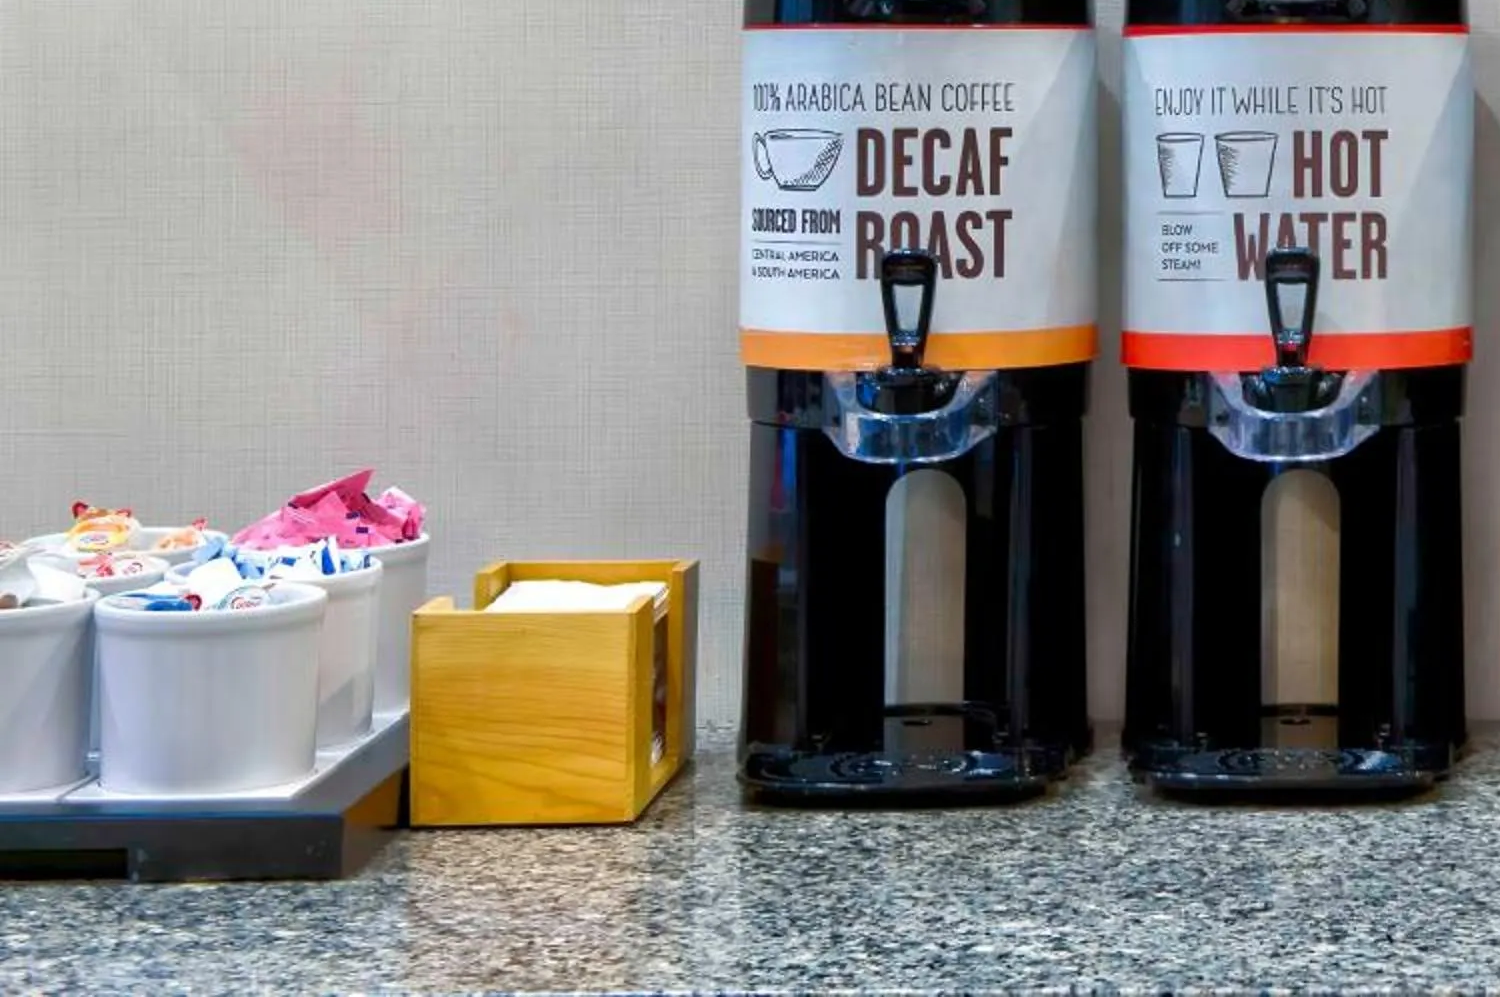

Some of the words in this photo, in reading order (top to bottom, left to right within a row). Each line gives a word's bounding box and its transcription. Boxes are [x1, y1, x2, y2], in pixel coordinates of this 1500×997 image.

[785, 83, 867, 112] ARABICA
[875, 83, 932, 112] BEAN
[941, 83, 1015, 112] COFFEE
[1155, 88, 1204, 116] ENJOY
[1211, 87, 1226, 115] IT
[1233, 86, 1298, 115] WHILE
[1309, 86, 1343, 114] IT'S
[1351, 86, 1388, 114] HOT
[856, 127, 1013, 197] DECAF
[1292, 130, 1389, 198] HOT
[752, 207, 797, 234] SOURCED
[801, 208, 841, 234] FROM
[1162, 224, 1193, 236] BLOW
[788, 250, 840, 262] AMERICA
[856, 209, 1013, 280] ROAST
[1162, 242, 1183, 254] OFF
[1185, 242, 1219, 254] SOME
[787, 268, 841, 280] AMERICA
